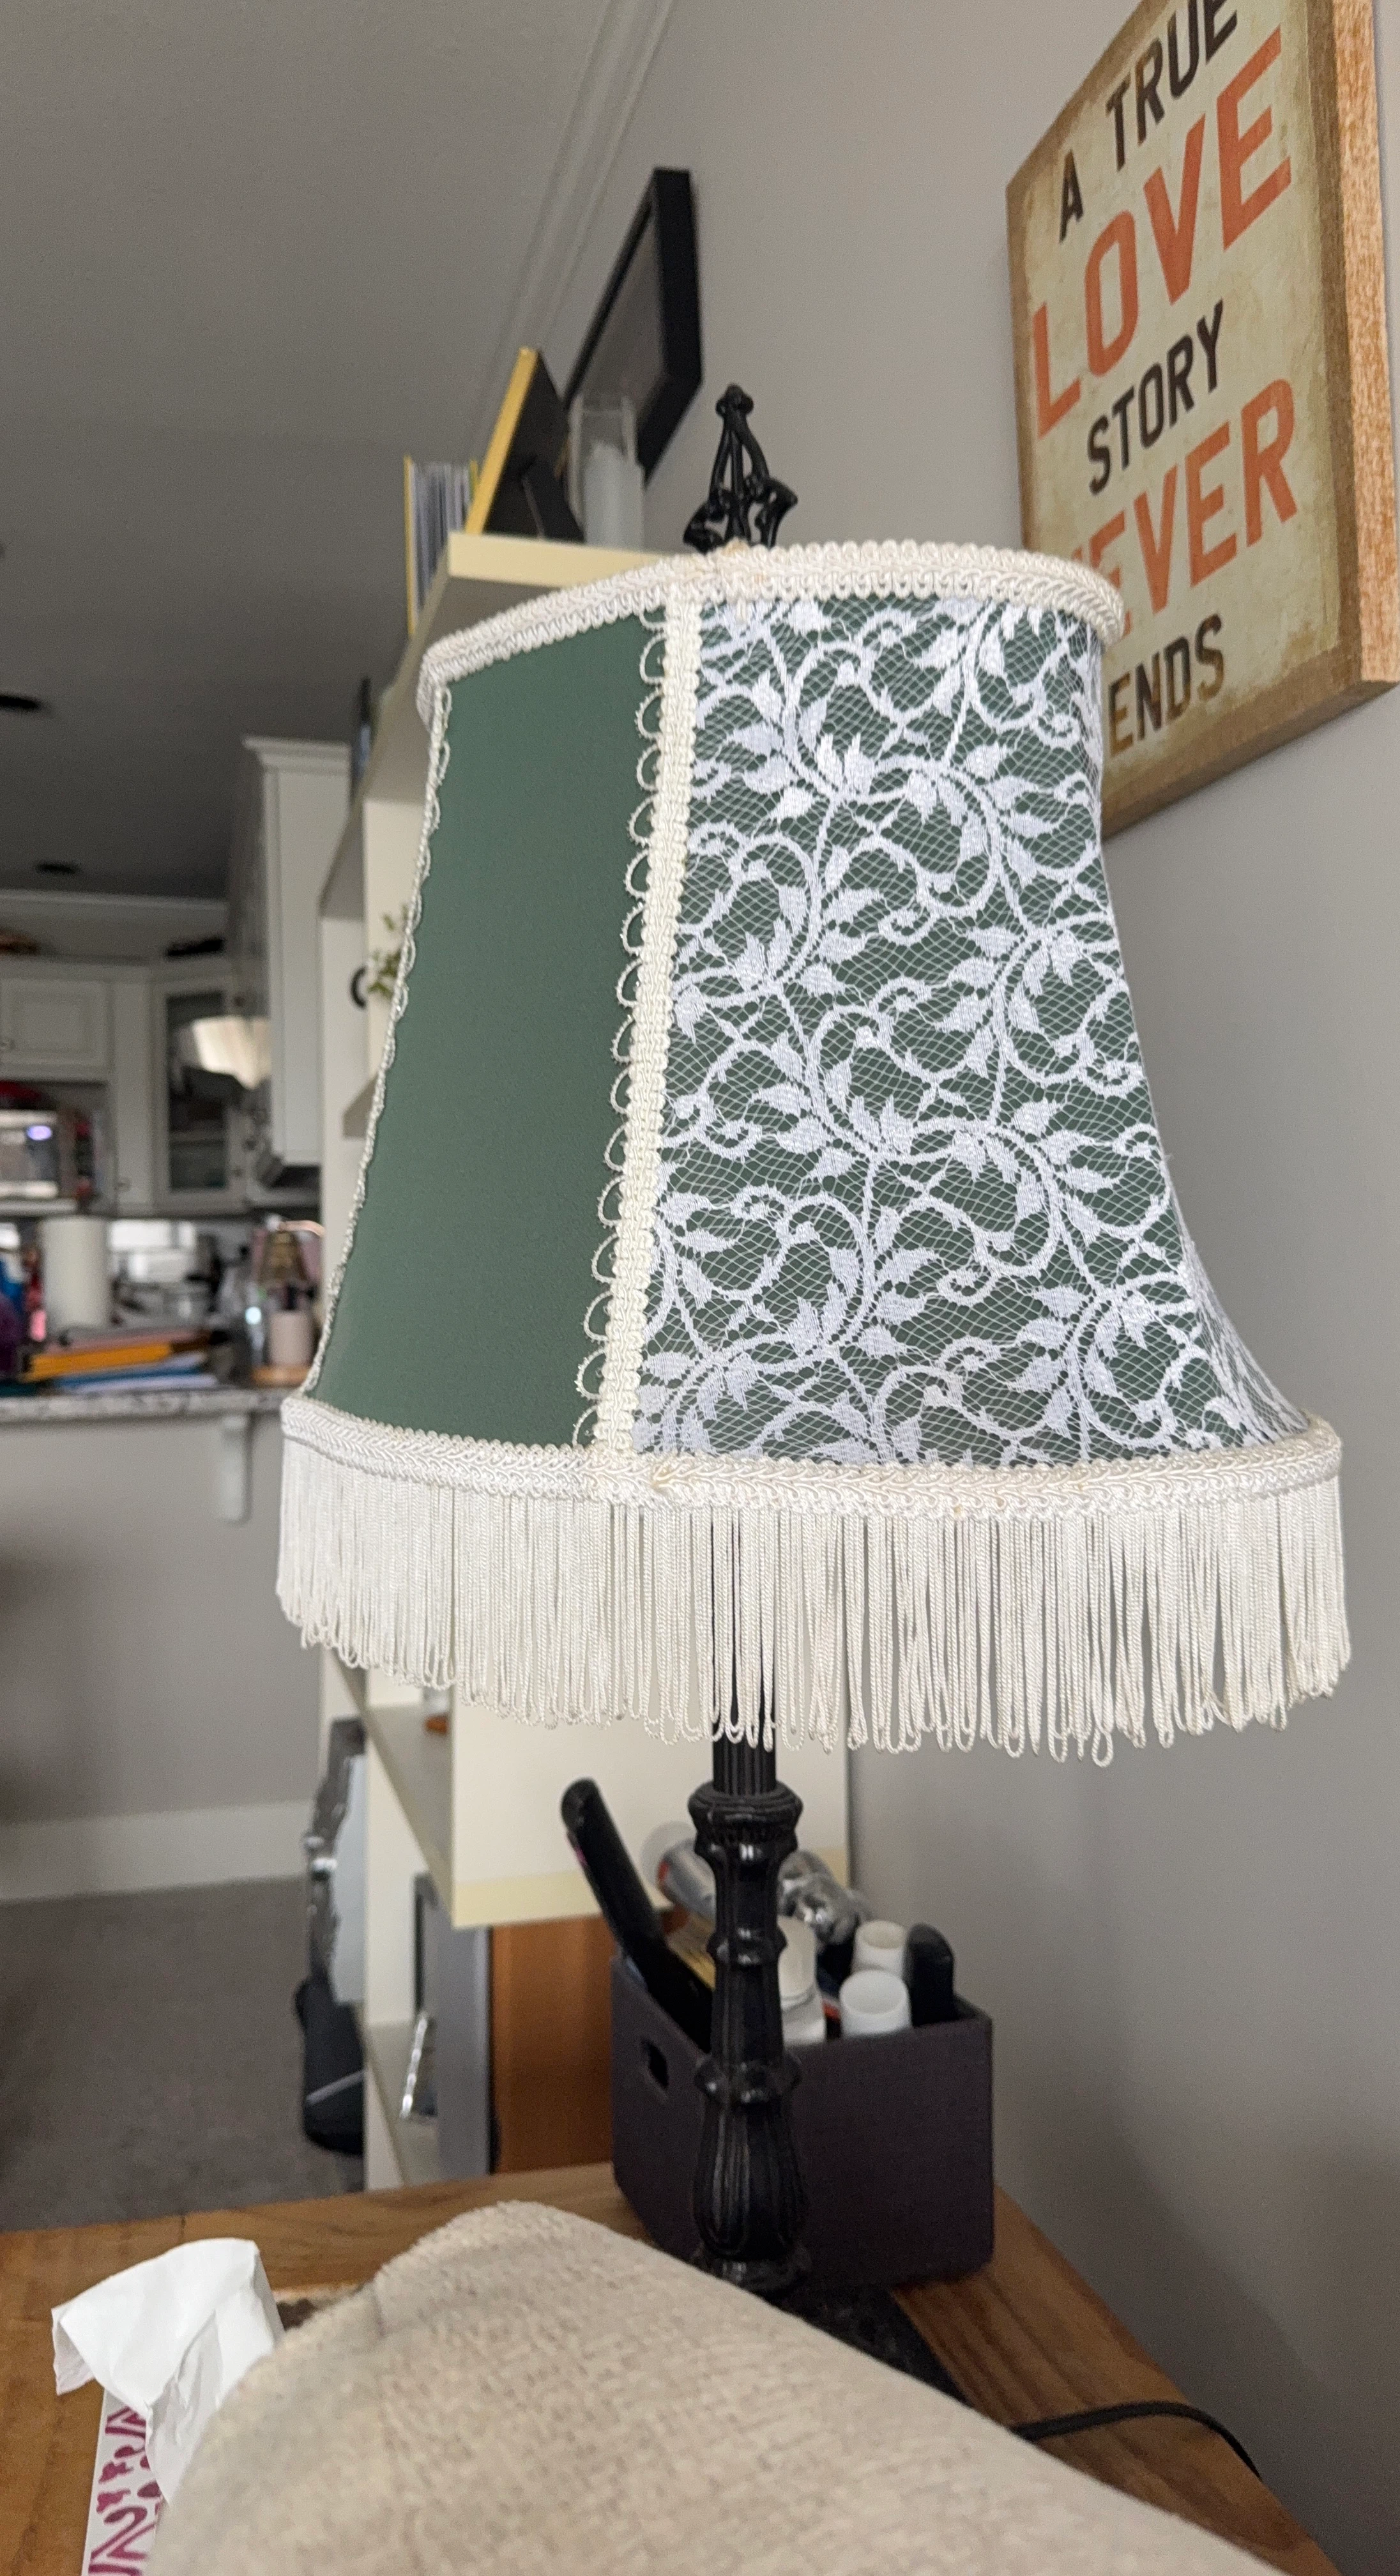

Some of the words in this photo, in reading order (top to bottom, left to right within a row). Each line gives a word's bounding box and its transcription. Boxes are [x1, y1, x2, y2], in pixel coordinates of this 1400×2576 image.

[1060, 149, 1084, 243] A
[1106, 0, 1237, 172] TRUE
[1032, 24, 1291, 441] LOVE
[1087, 298, 1224, 496] STORY
[1109, 613, 1225, 758] ENDS
